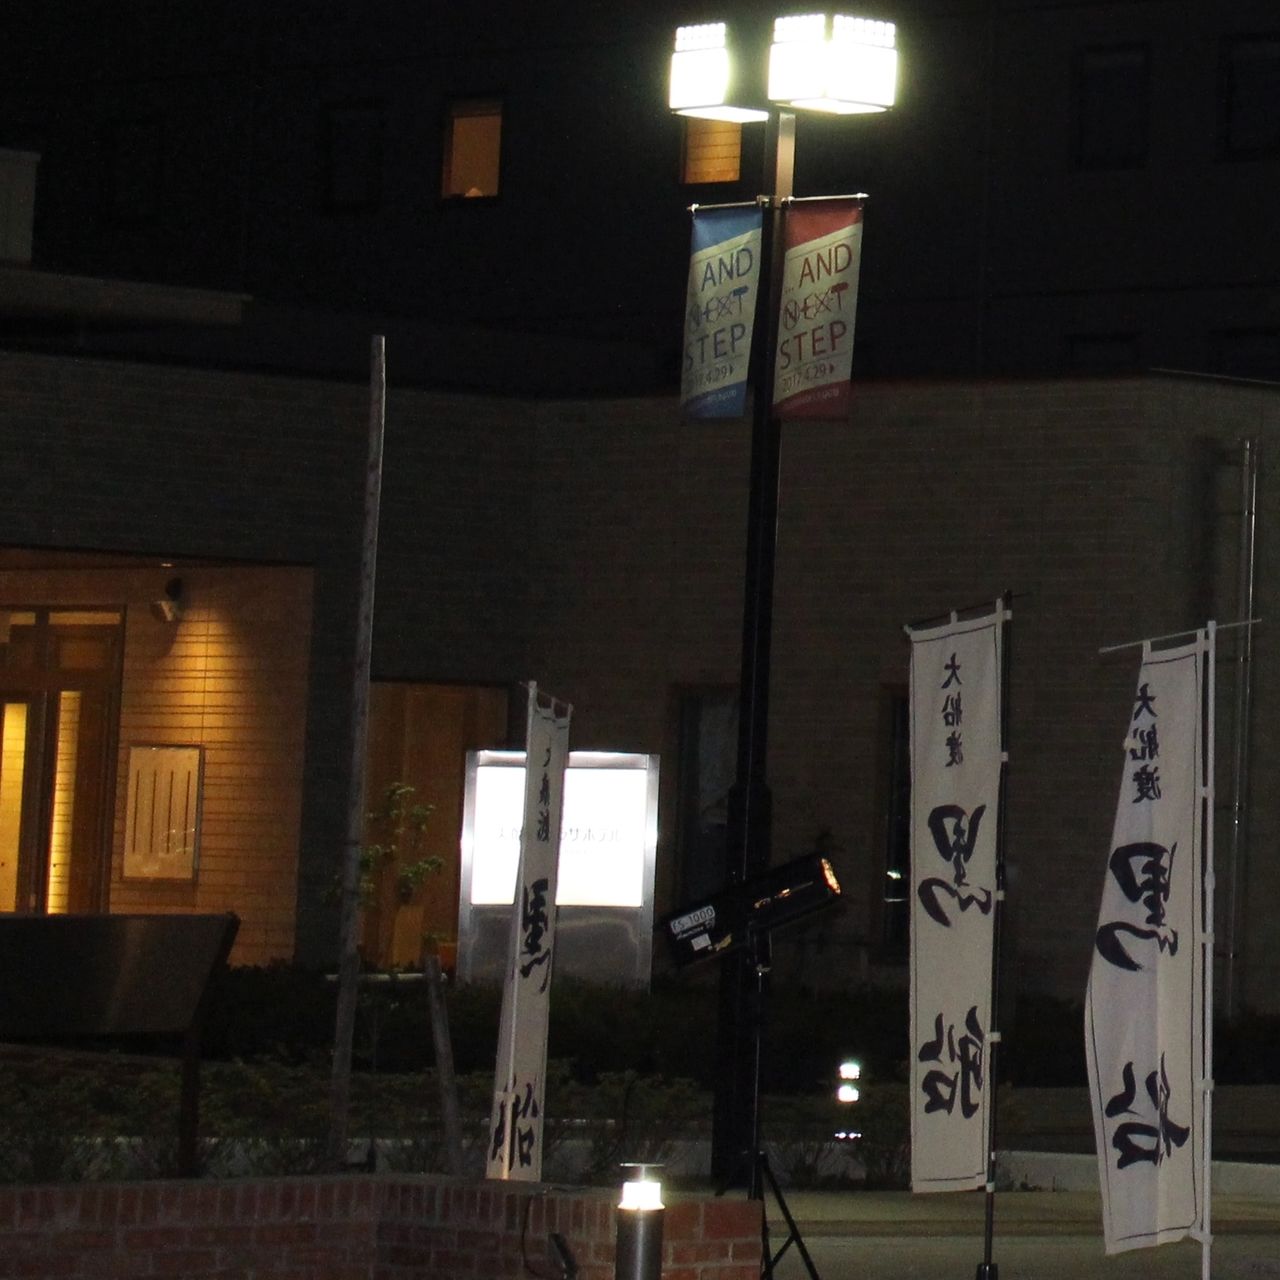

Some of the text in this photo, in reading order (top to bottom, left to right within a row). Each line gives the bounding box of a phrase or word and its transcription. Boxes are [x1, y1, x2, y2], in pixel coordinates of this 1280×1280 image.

[784, 282, 849, 330] NEXT
[685, 323, 746, 370] STEP
[780, 320, 847, 369] STEP
